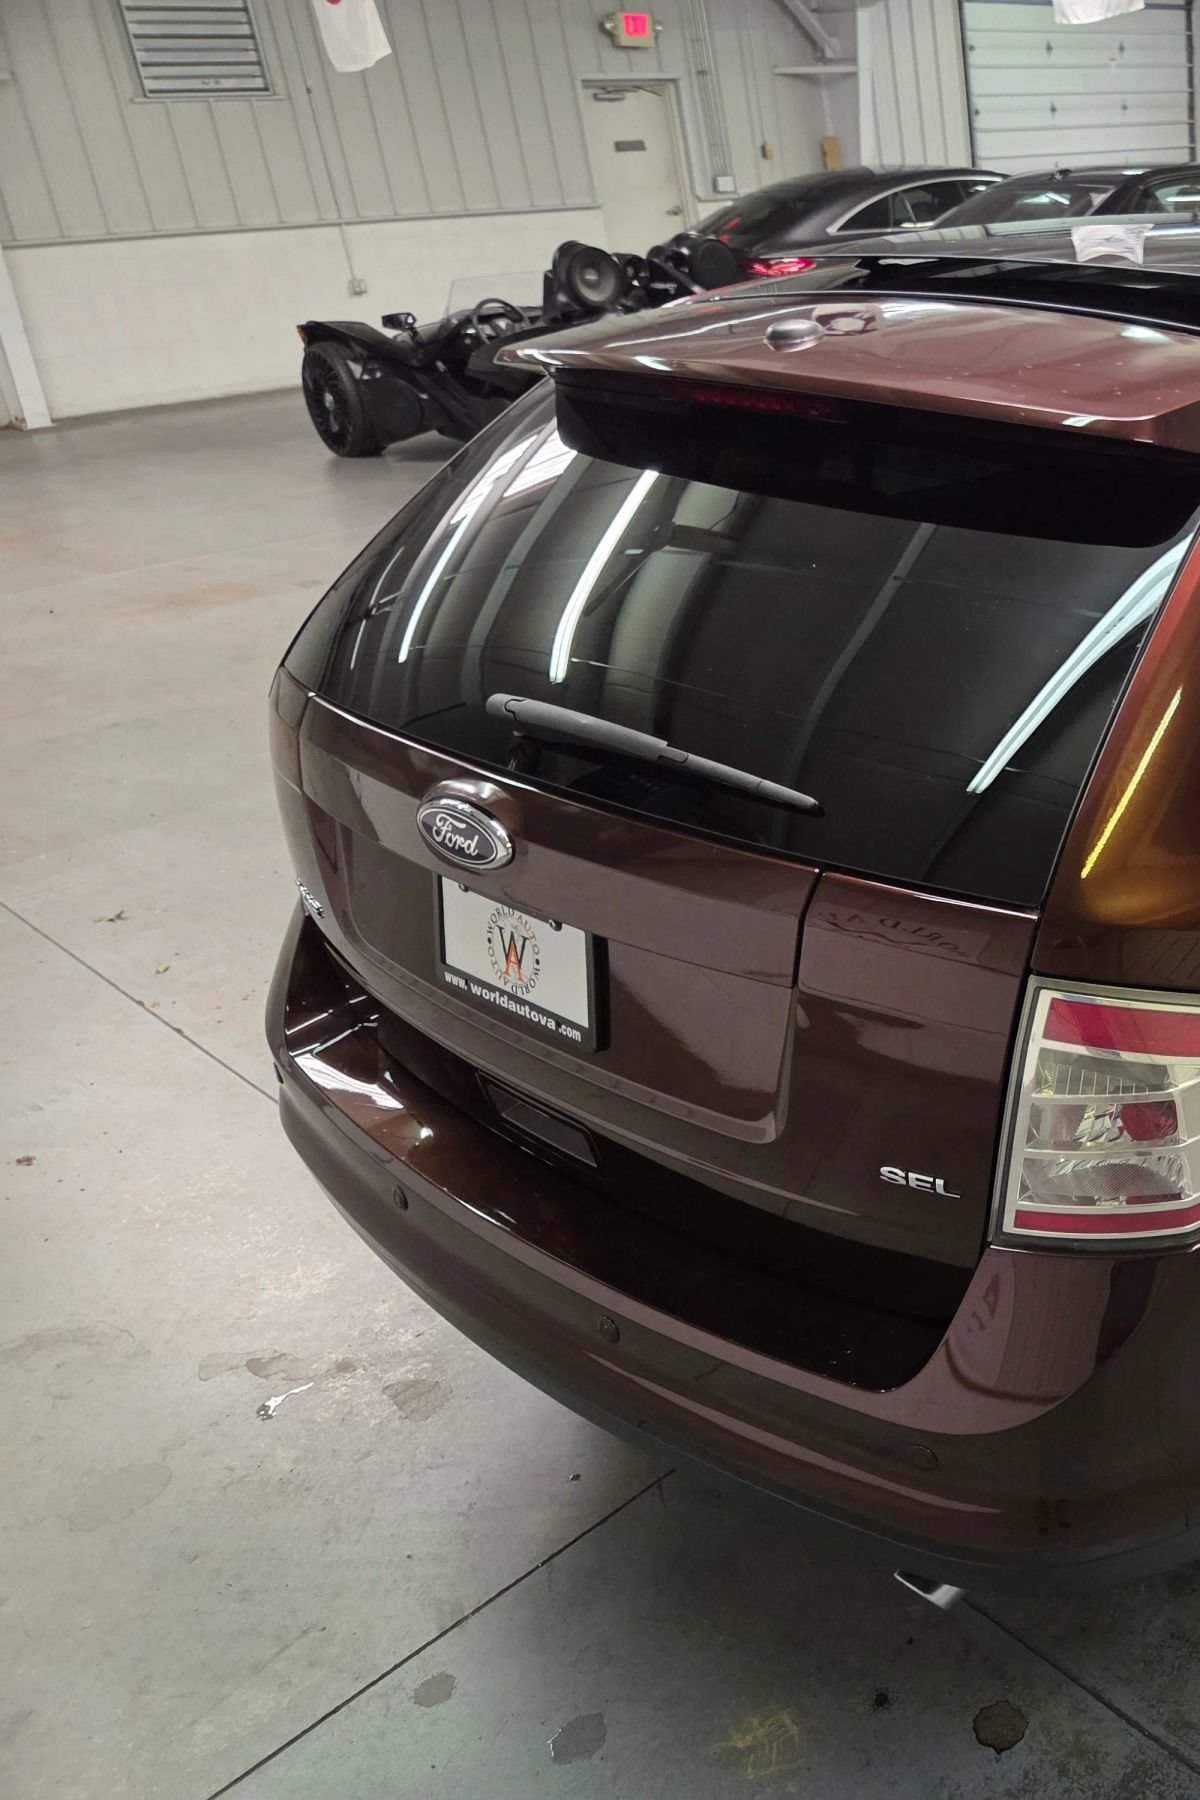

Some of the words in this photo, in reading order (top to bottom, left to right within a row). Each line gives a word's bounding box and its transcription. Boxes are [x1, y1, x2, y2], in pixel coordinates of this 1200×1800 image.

[432, 813, 479, 856] Ford
[487, 906, 515, 935] WORLD
[517, 914, 540, 956] AUTO
[511, 967, 541, 996] WORLD
[444, 970, 467, 990] www.
[470, 982, 556, 1031] worldautova
[558, 1024, 582, 1043] .com
[880, 1166, 961, 1199] SEL
